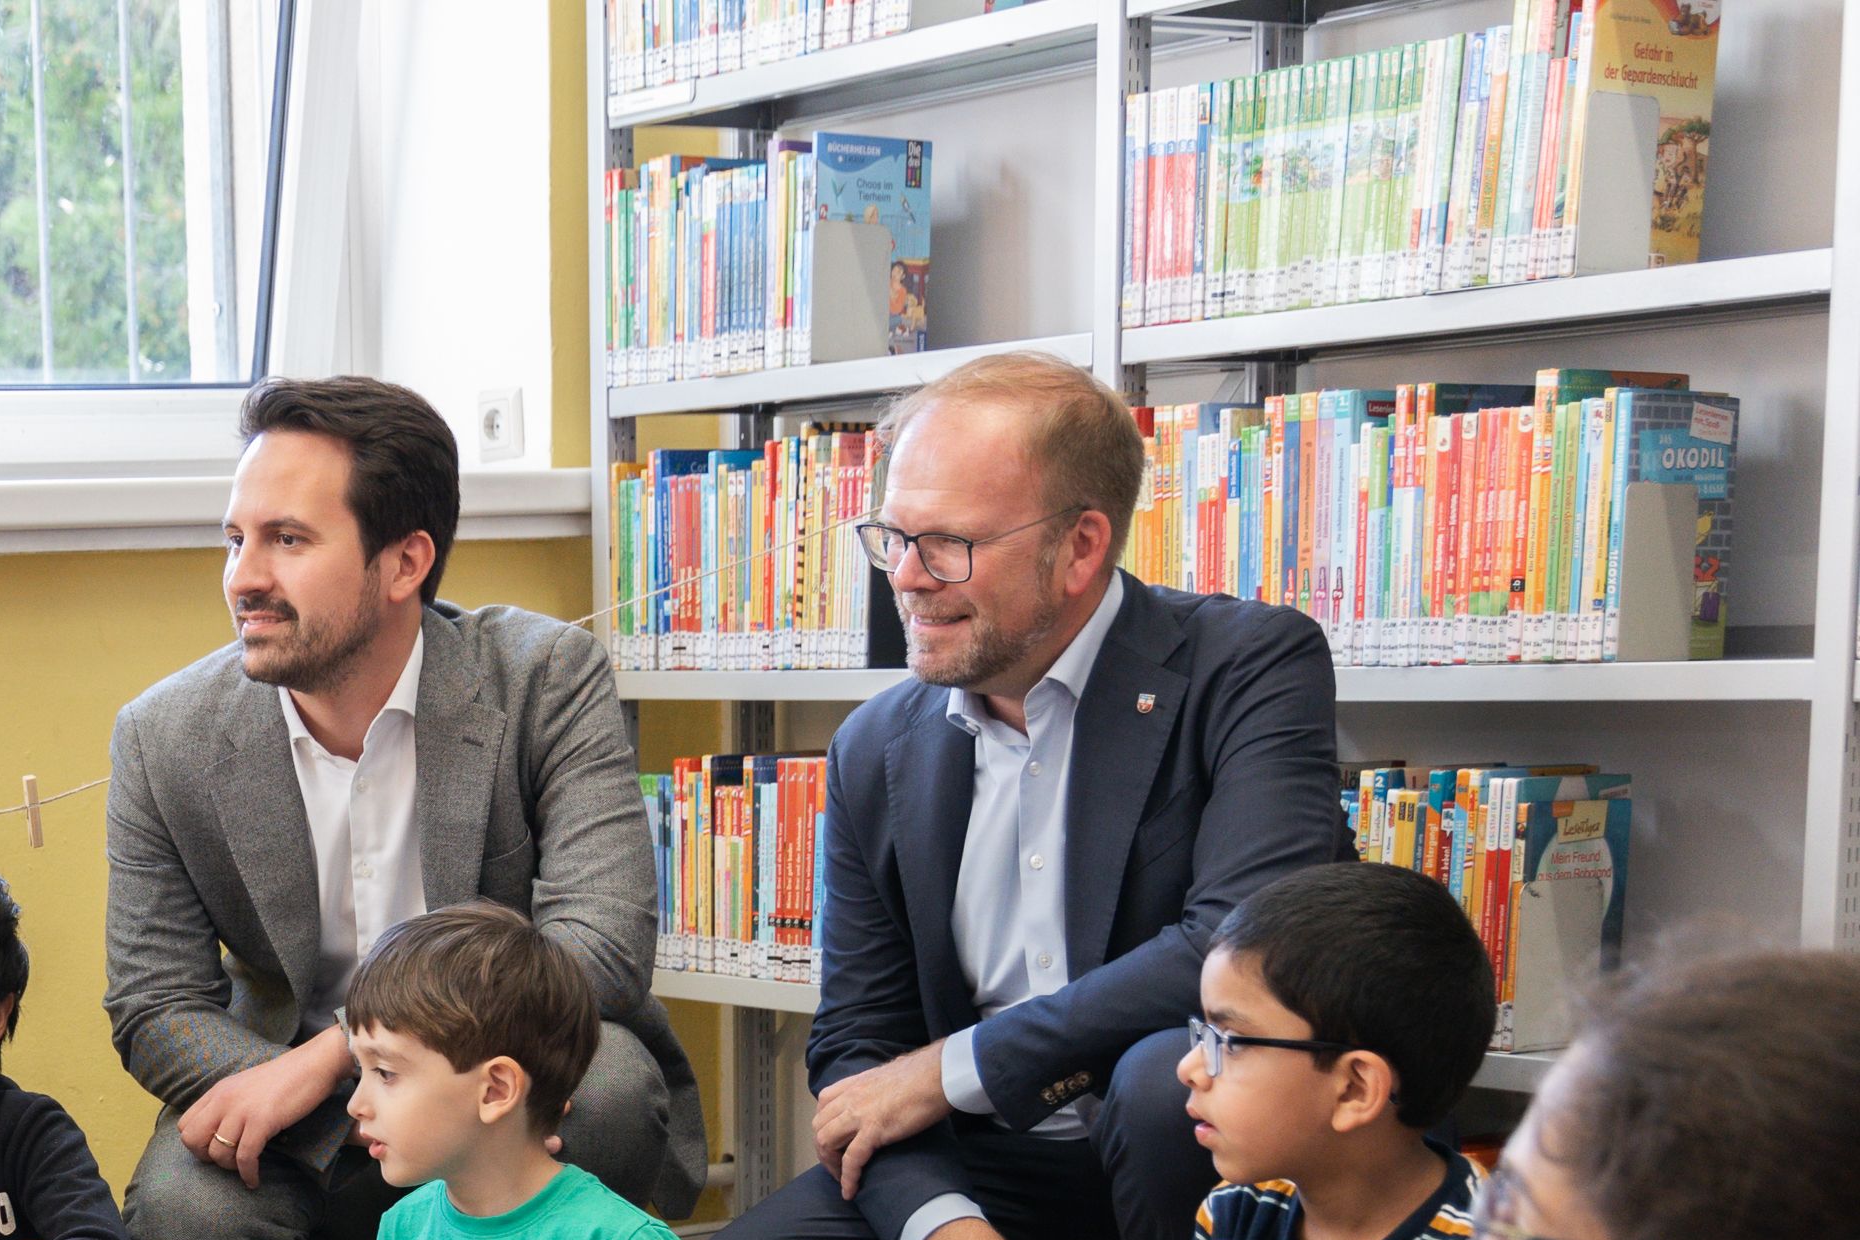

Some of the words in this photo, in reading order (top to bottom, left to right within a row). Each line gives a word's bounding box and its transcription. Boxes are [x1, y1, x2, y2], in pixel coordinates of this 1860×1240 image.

[1634, 42, 1663, 61] Gefahr
[1665, 45, 1674, 62] in
[1604, 63, 1619, 80] der
[1622, 64, 1698, 89] Gepardenschlucht
[908, 141, 921, 156] Die
[856, 177, 881, 190] Chaos
[858, 190, 891, 203] Tierheim
[1375, 775, 1385, 788] 2
[1359, 812, 1369, 830] ZUG
[1488, 801, 1498, 847] LESESTARTER
[1501, 801, 1512, 847] LESESTARTER
[1562, 818, 1600, 836] Lesetiger
[1455, 820, 1465, 849] pfeift!
[1425, 823, 1437, 868] Untergang!
[1441, 846, 1451, 870] beben!
[1551, 852, 1571, 864] Mein
[1573, 850, 1601, 862] Freund
[1452, 850, 1462, 884] Schwein
[1538, 872, 1553, 881] aus
[1554, 869, 1571, 880] dem
[1573, 867, 1612, 878] Roboland
